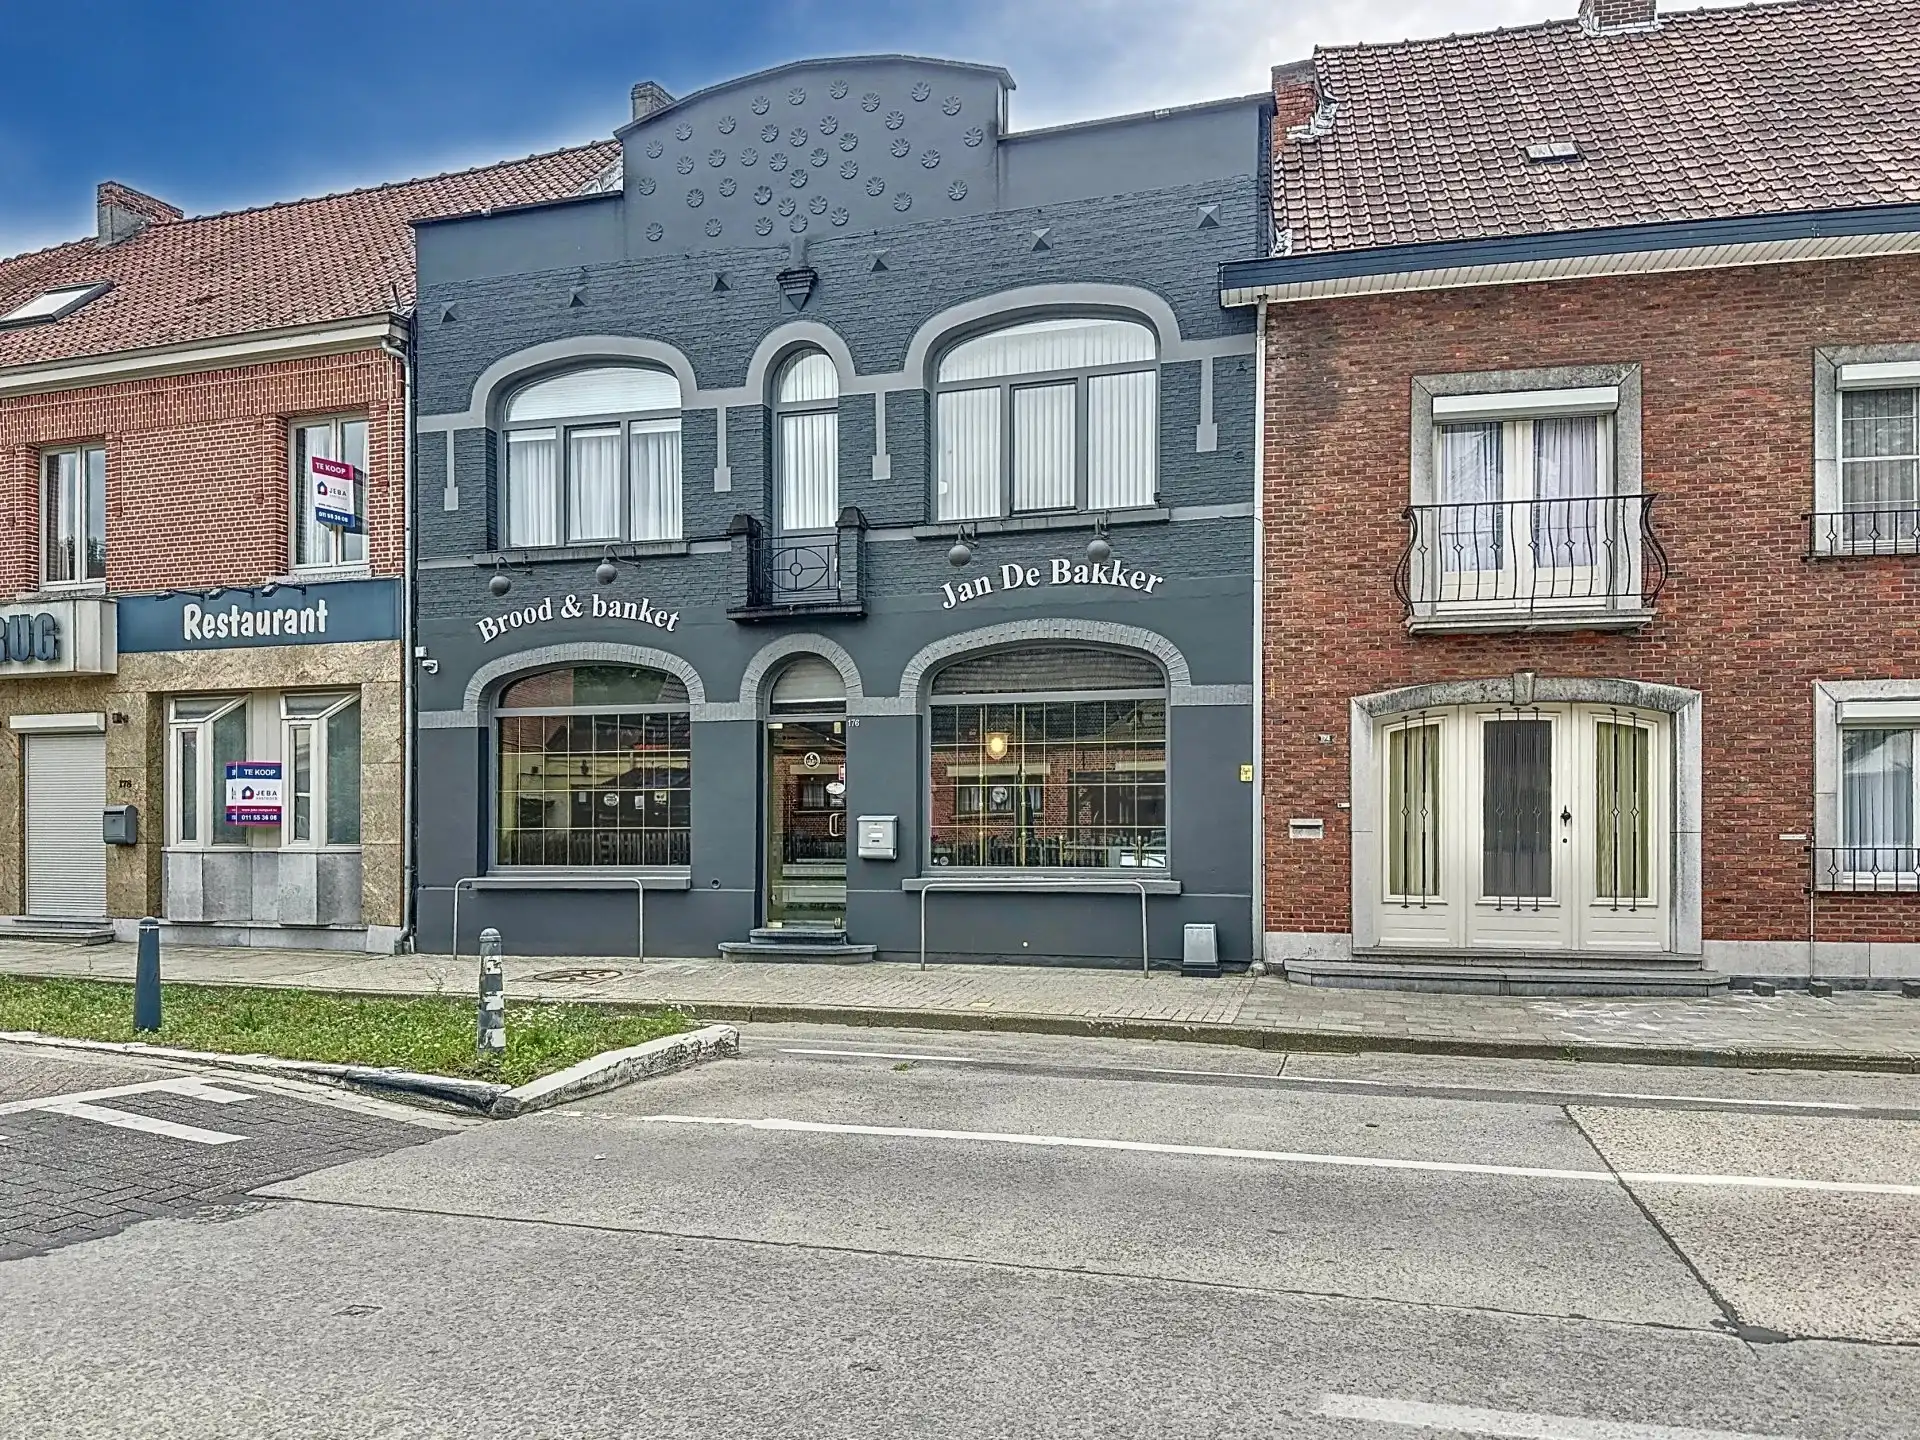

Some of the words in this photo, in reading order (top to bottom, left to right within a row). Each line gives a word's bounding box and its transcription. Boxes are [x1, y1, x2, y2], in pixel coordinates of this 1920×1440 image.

[315, 462, 324, 470] TE
[325, 464, 345, 474] KOOP
[329, 488, 347, 496] JEBA
[939, 575, 994, 610] Jan
[999, 563, 1041, 590] De
[1049, 558, 1164, 594] Bakker
[183, 599, 329, 641] Restaurant
[475, 596, 554, 643] Brood
[560, 594, 584, 619] &
[592, 594, 680, 632] banket
[0, 612, 56, 662] UG
[847, 719, 860, 727] 176
[119, 780, 132, 788] 178
